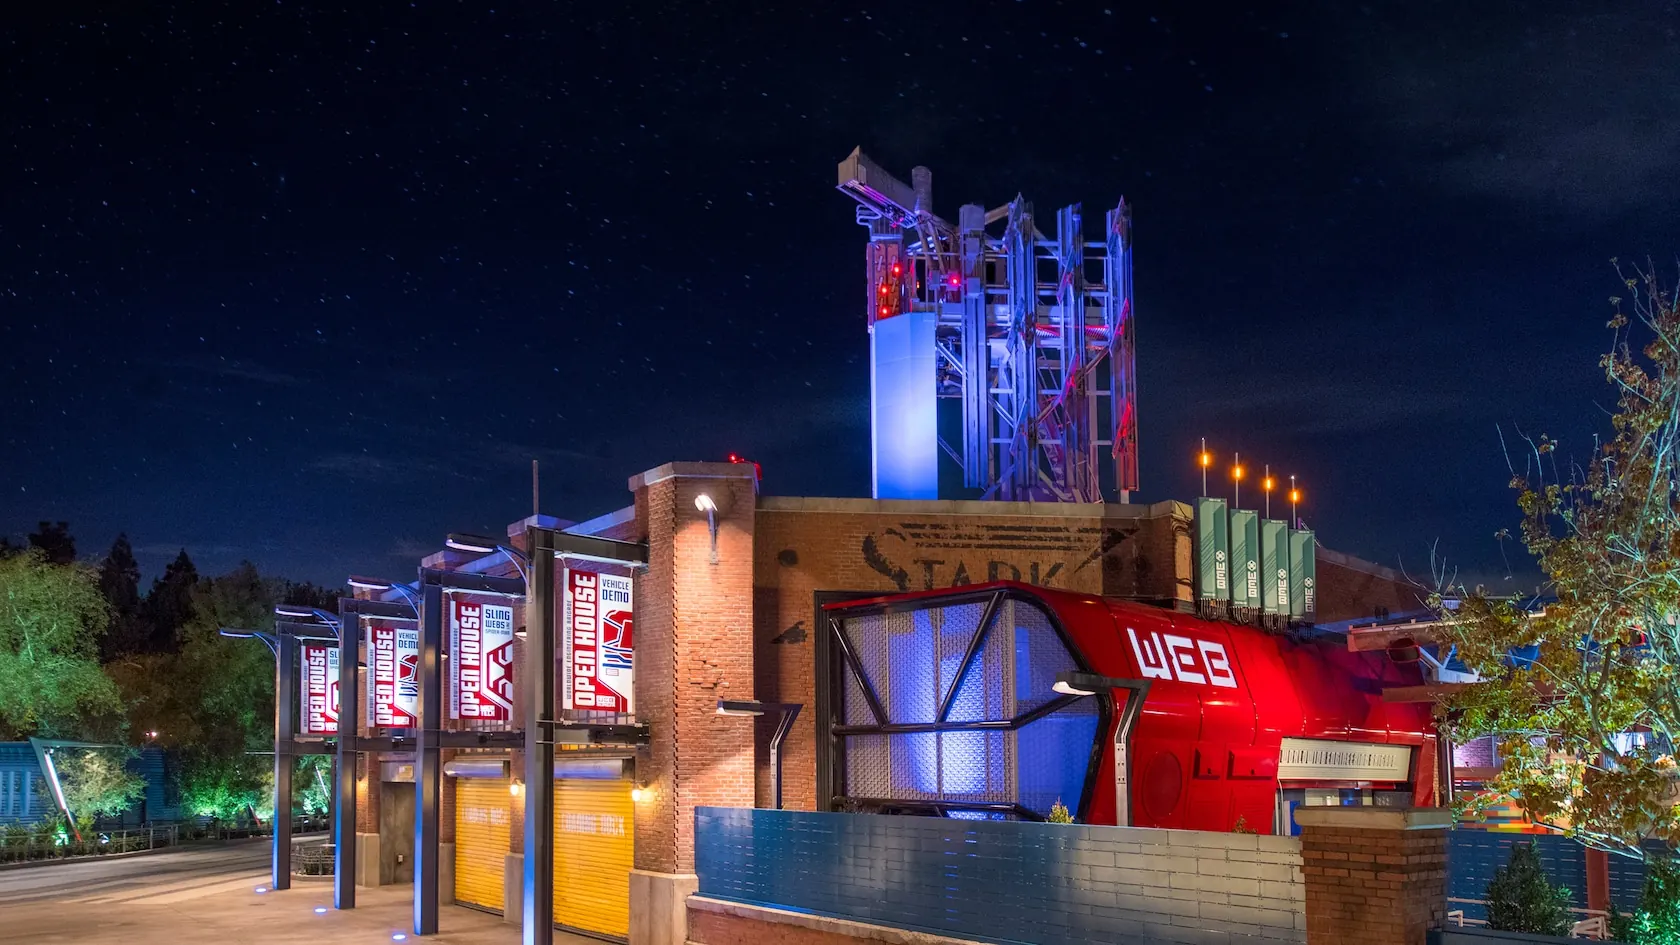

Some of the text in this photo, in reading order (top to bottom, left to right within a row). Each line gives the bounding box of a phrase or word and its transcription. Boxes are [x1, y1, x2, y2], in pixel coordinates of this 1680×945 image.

[602, 578, 629, 590] VEHICLE
[1216, 562, 1226, 589] WEB
[1248, 571, 1257, 598] WEB
[602, 589, 629, 603] DEMO
[1278, 579, 1287, 605] WEB
[1304, 588, 1313, 612] WEB
[485, 609, 510, 620] SLING
[485, 620, 506, 629] WEBS
[574, 574, 596, 706] OPEN HOUSE
[461, 606, 480, 716] OPEN HOUSE
[1126, 627, 1238, 688] WEB
[309, 649, 326, 731] OPEN HOUSE
[376, 630, 394, 725] OPEN HOUSE
